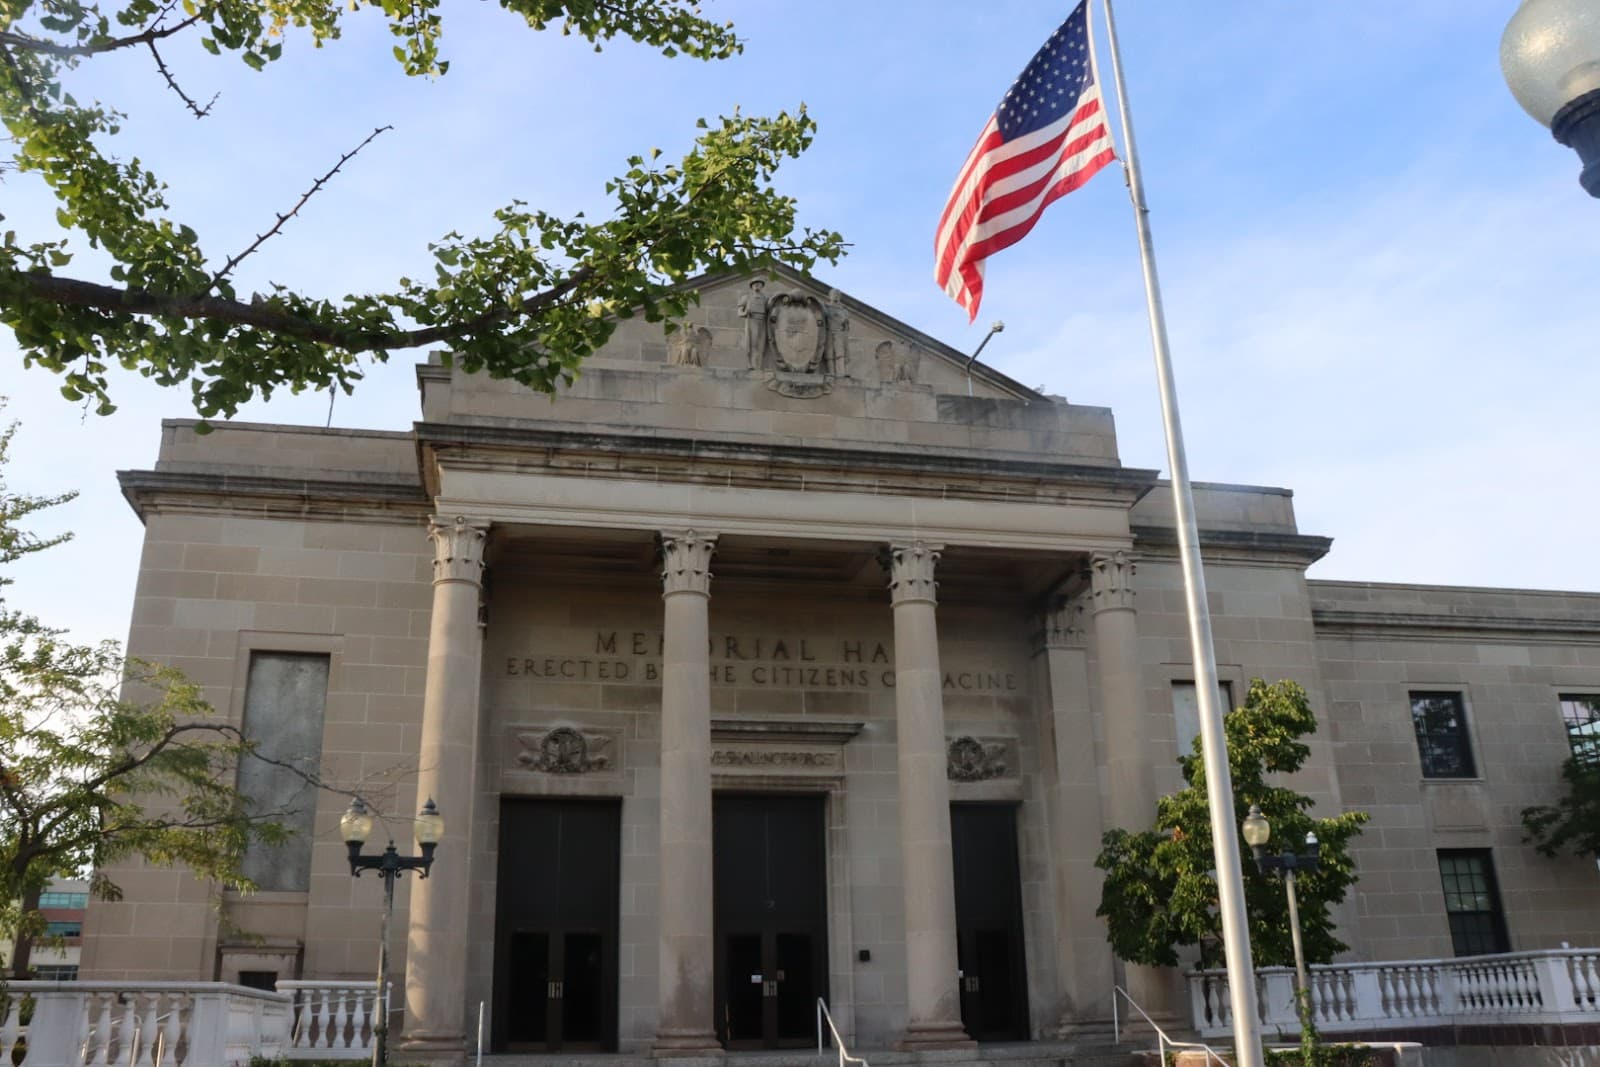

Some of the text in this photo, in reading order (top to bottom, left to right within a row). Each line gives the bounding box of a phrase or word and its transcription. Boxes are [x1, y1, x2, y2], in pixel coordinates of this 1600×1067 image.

[596, 631, 815, 661] MERIAL
[506, 657, 629, 681] ERECTED
[709, 665, 737, 682] HE
[751, 666, 869, 688] CITIZENS
[943, 672, 1017, 691] ACINE
